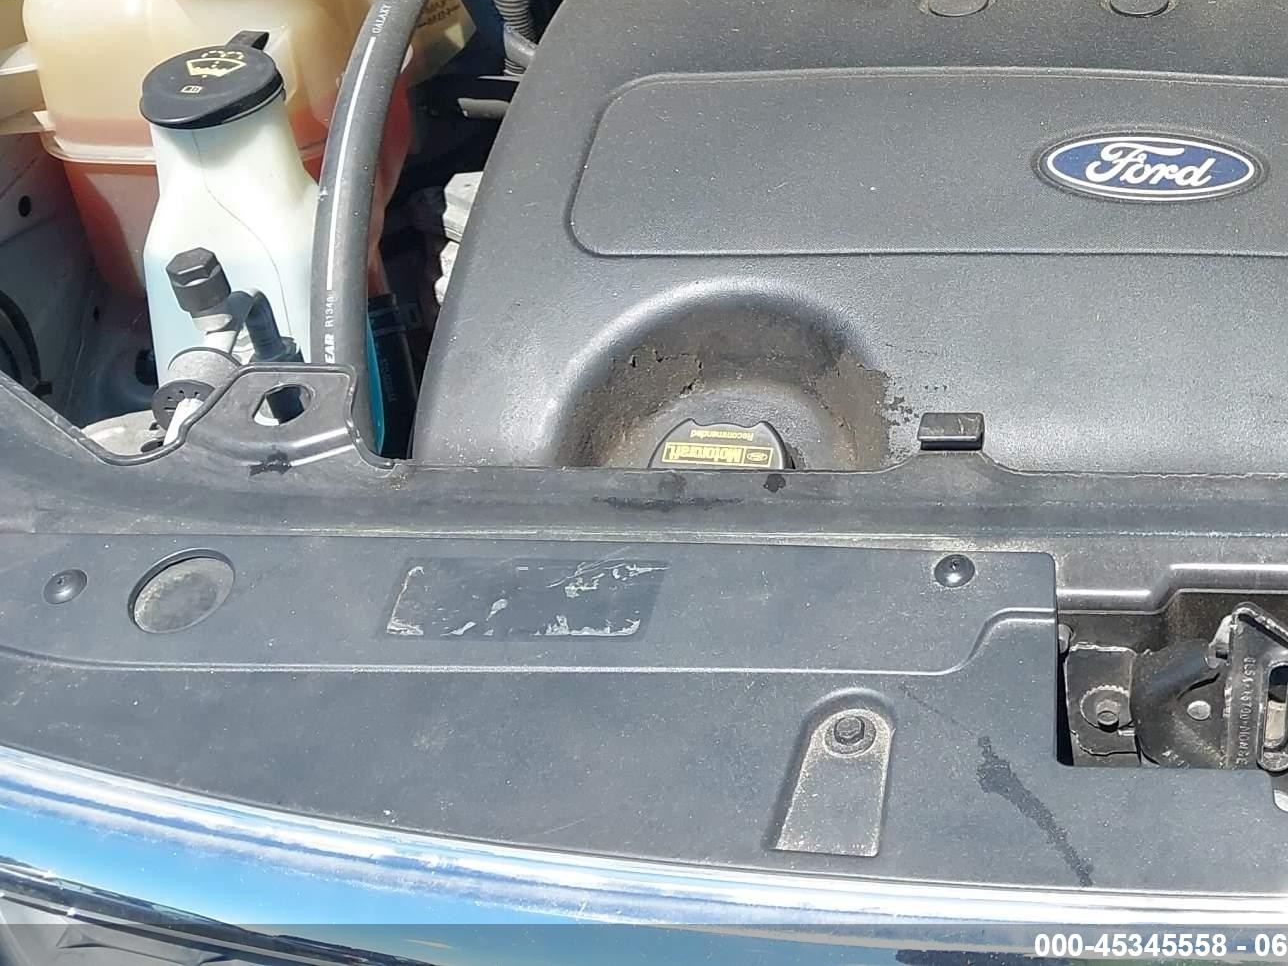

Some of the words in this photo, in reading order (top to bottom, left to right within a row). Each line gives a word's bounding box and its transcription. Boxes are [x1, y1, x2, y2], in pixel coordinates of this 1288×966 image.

[372, 3, 392, 34] GALAXY
[1086, 142, 1216, 187] Ford
[689, 429, 755, 442] Recommended
[668, 445, 743, 463] Motorcraft
